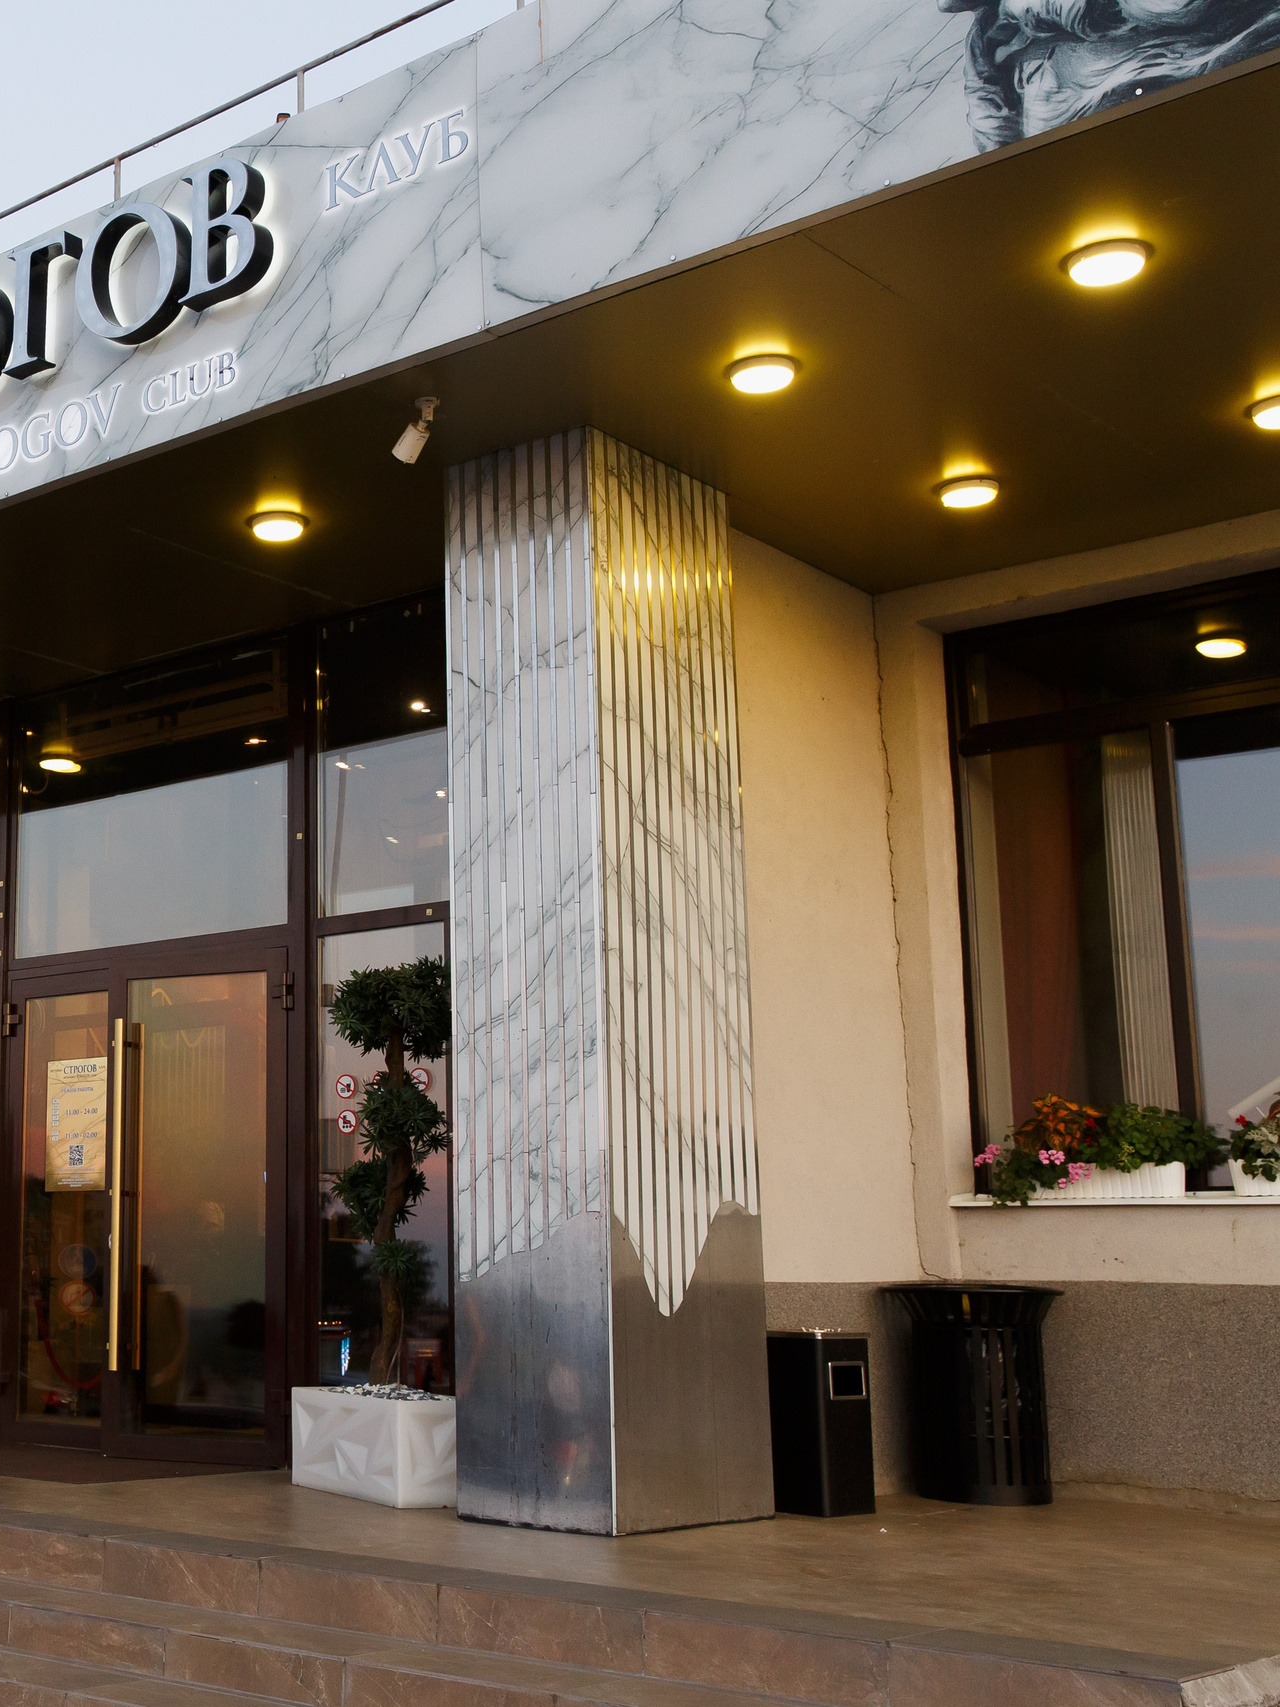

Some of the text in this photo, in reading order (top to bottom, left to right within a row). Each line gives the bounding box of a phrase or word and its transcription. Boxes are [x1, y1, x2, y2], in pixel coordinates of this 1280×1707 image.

[325, 109, 469, 211] КЛУБ
[142, 351, 236, 412] CLUB
[63, 1064, 97, 1074] СТРОГОВ
